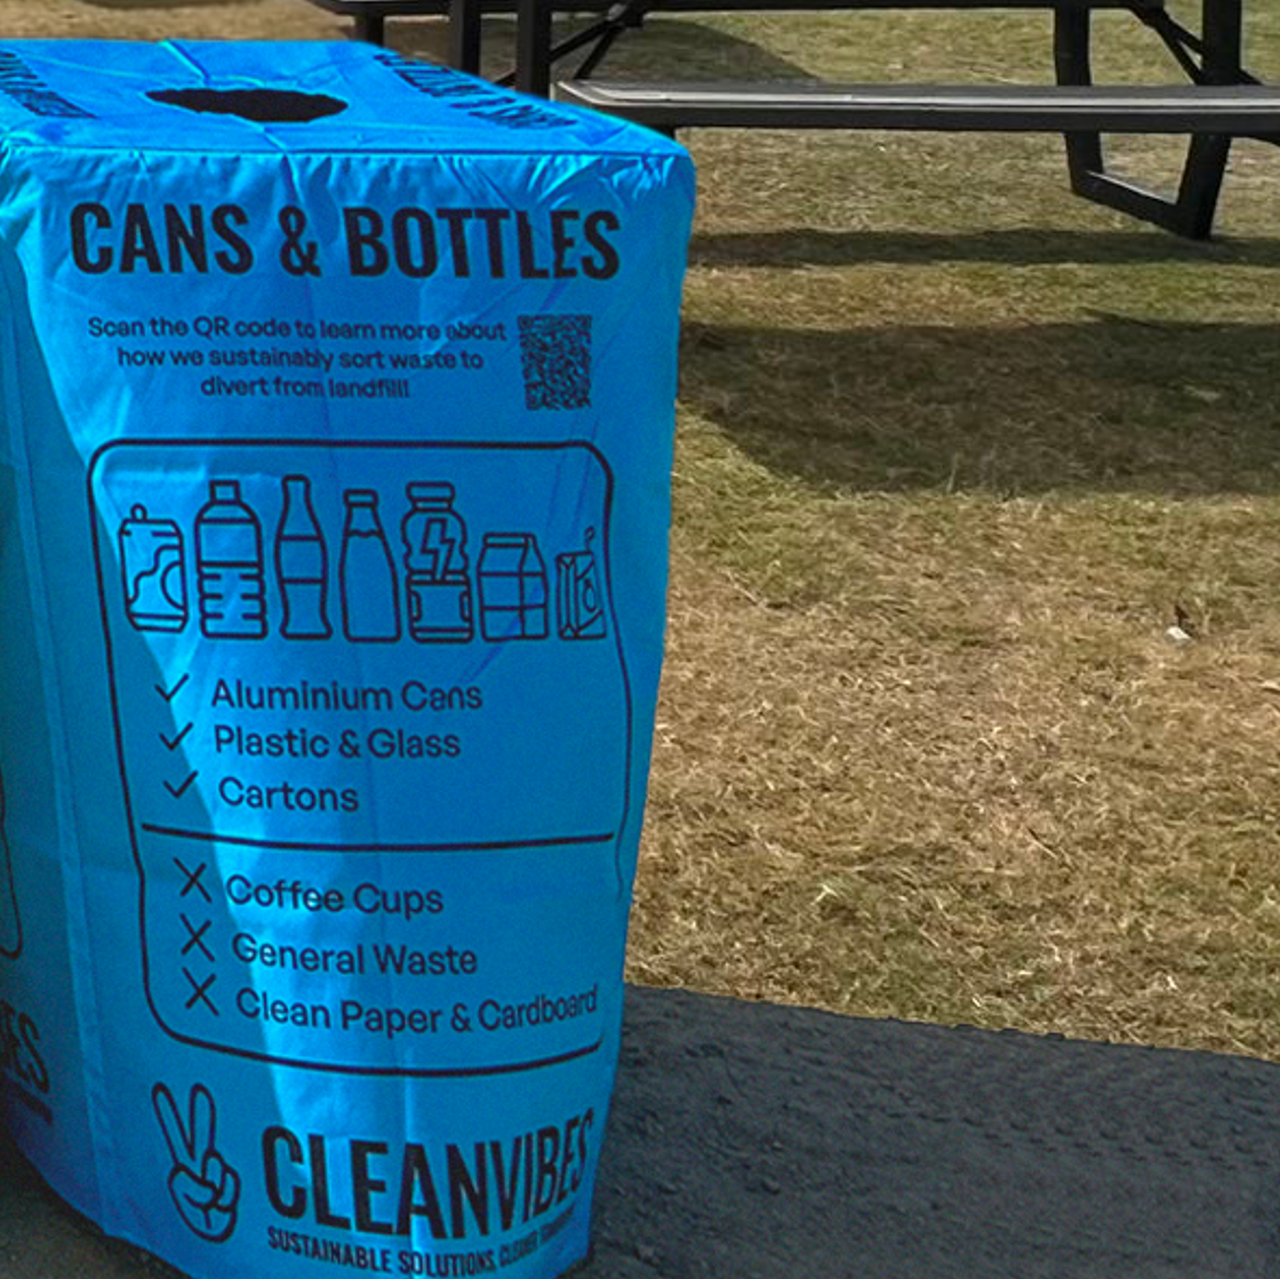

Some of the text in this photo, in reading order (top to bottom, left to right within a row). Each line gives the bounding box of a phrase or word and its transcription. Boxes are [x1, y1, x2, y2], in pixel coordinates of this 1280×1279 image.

[70, 202, 620, 281] CANS & BOTTLES
[87, 317, 507, 342] Scan the QR code to learn more about
[117, 347, 484, 372] how we sustainably sort waste to
[201, 377, 269, 397] divert
[273, 377, 324, 399] from
[212, 678, 483, 711] Aluminium Cans
[215, 726, 460, 760] Plastic & Glass
[219, 777, 358, 812] Cartons
[226, 875, 444, 920] Coffee Cups
[232, 933, 478, 976] General Waste
[237, 984, 598, 1039] Clean Paper & Cardboard
[261, 1107, 594, 1240] CLEANVIBES
[268, 1227, 390, 1273] SUSTAINABLE
